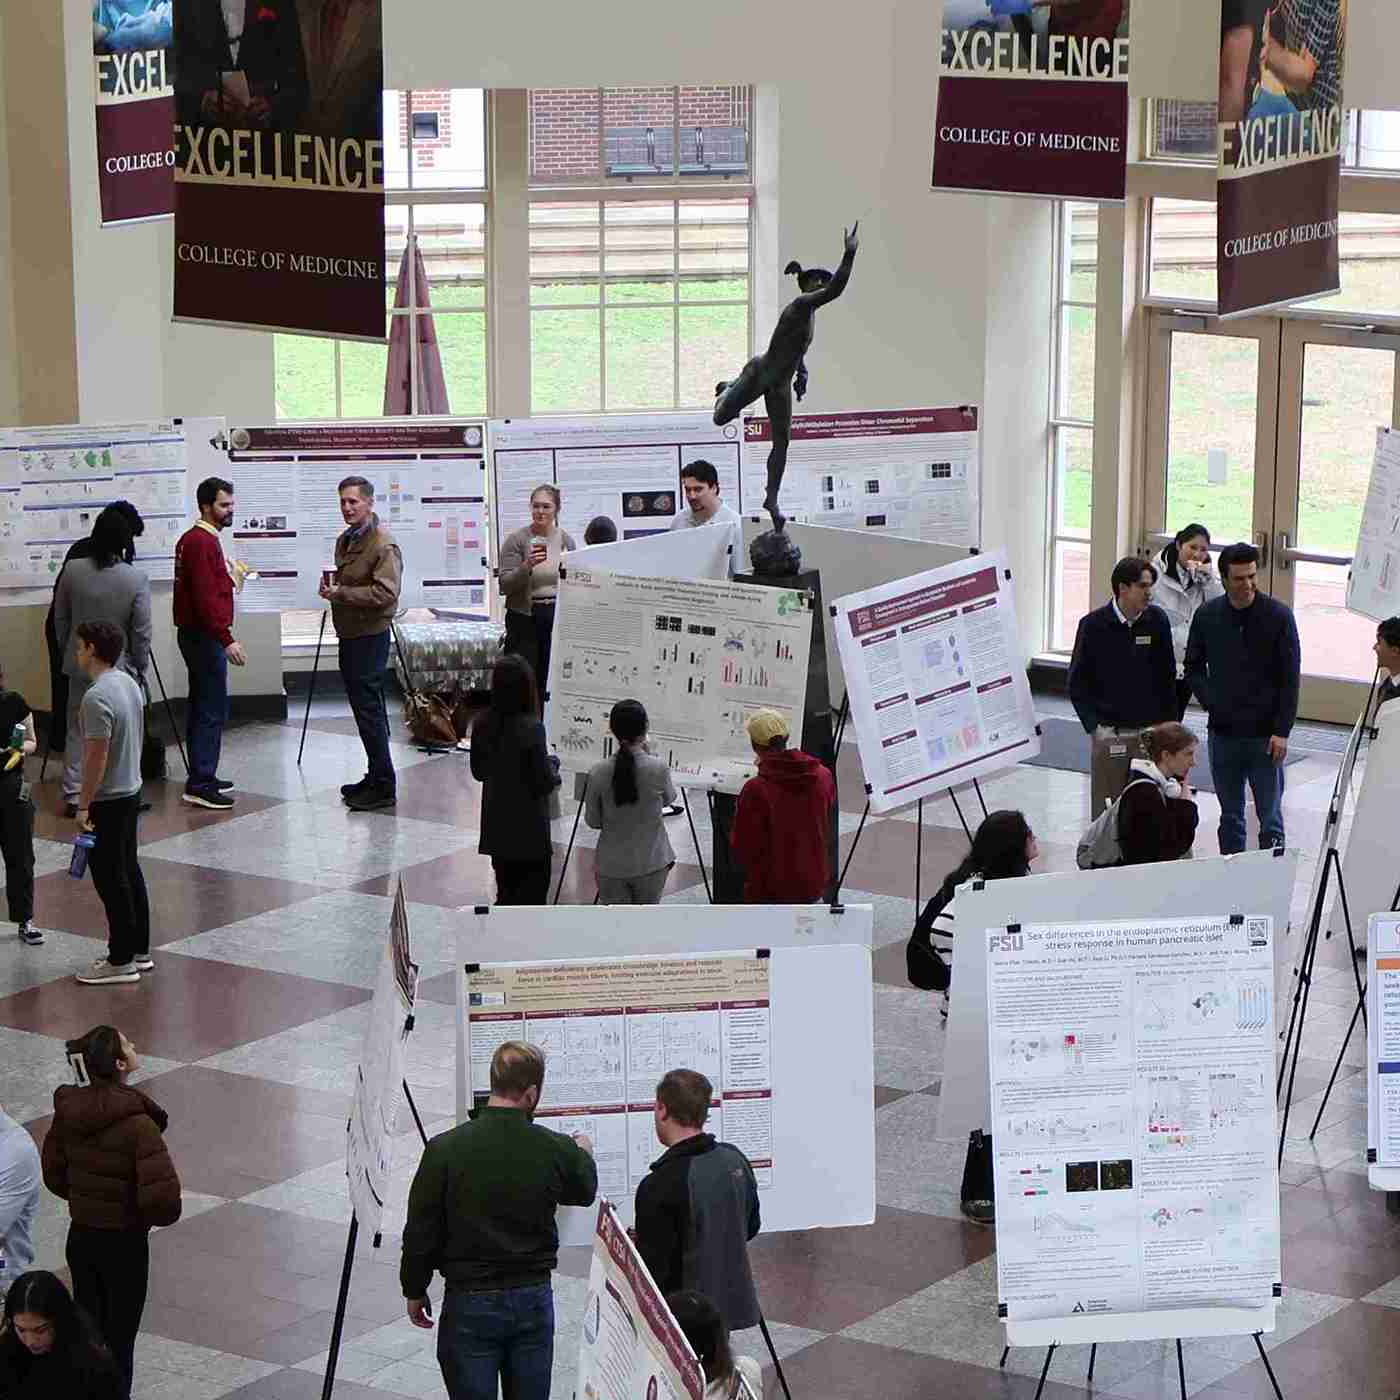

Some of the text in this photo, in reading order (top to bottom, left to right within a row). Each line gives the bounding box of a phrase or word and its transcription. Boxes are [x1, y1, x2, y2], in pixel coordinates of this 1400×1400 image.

[939, 30, 1128, 78] EXCELLENCE
[939, 126, 1120, 153] COLLEGE OF MEDICINE
[1220, 108, 1340, 172] EXCELLENC
[106, 153, 163, 175] COLLEGE
[1224, 231, 1274, 257] COLLEGE
[1274, 229, 1290, 250] OF
[178, 242, 378, 281] COLLEGE OF MEDICINE
[989, 935, 1024, 953] FSU
[1073, 939, 1114, 952] response
[1125, 936, 1158, 947] human
[1158, 934, 1204, 948] pancreatic
